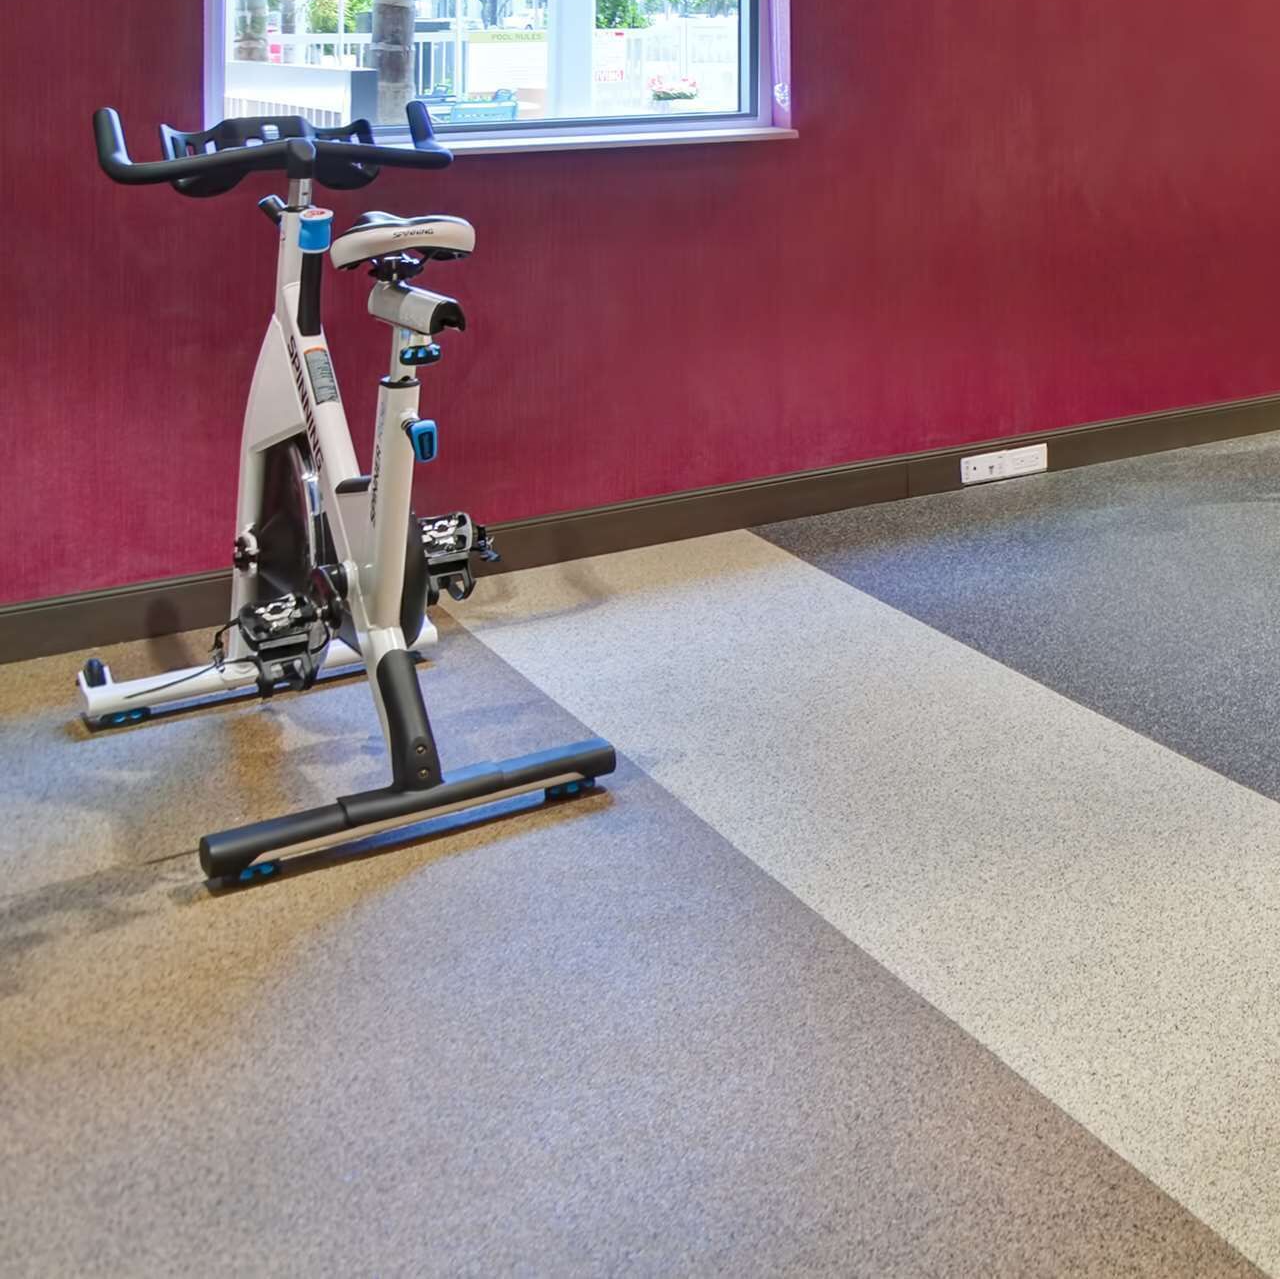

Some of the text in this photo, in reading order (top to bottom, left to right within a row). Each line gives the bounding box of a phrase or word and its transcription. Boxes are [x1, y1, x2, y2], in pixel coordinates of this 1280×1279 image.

[491, 31, 543, 41] POOL RULES
[287, 335, 325, 472] SPINNING
